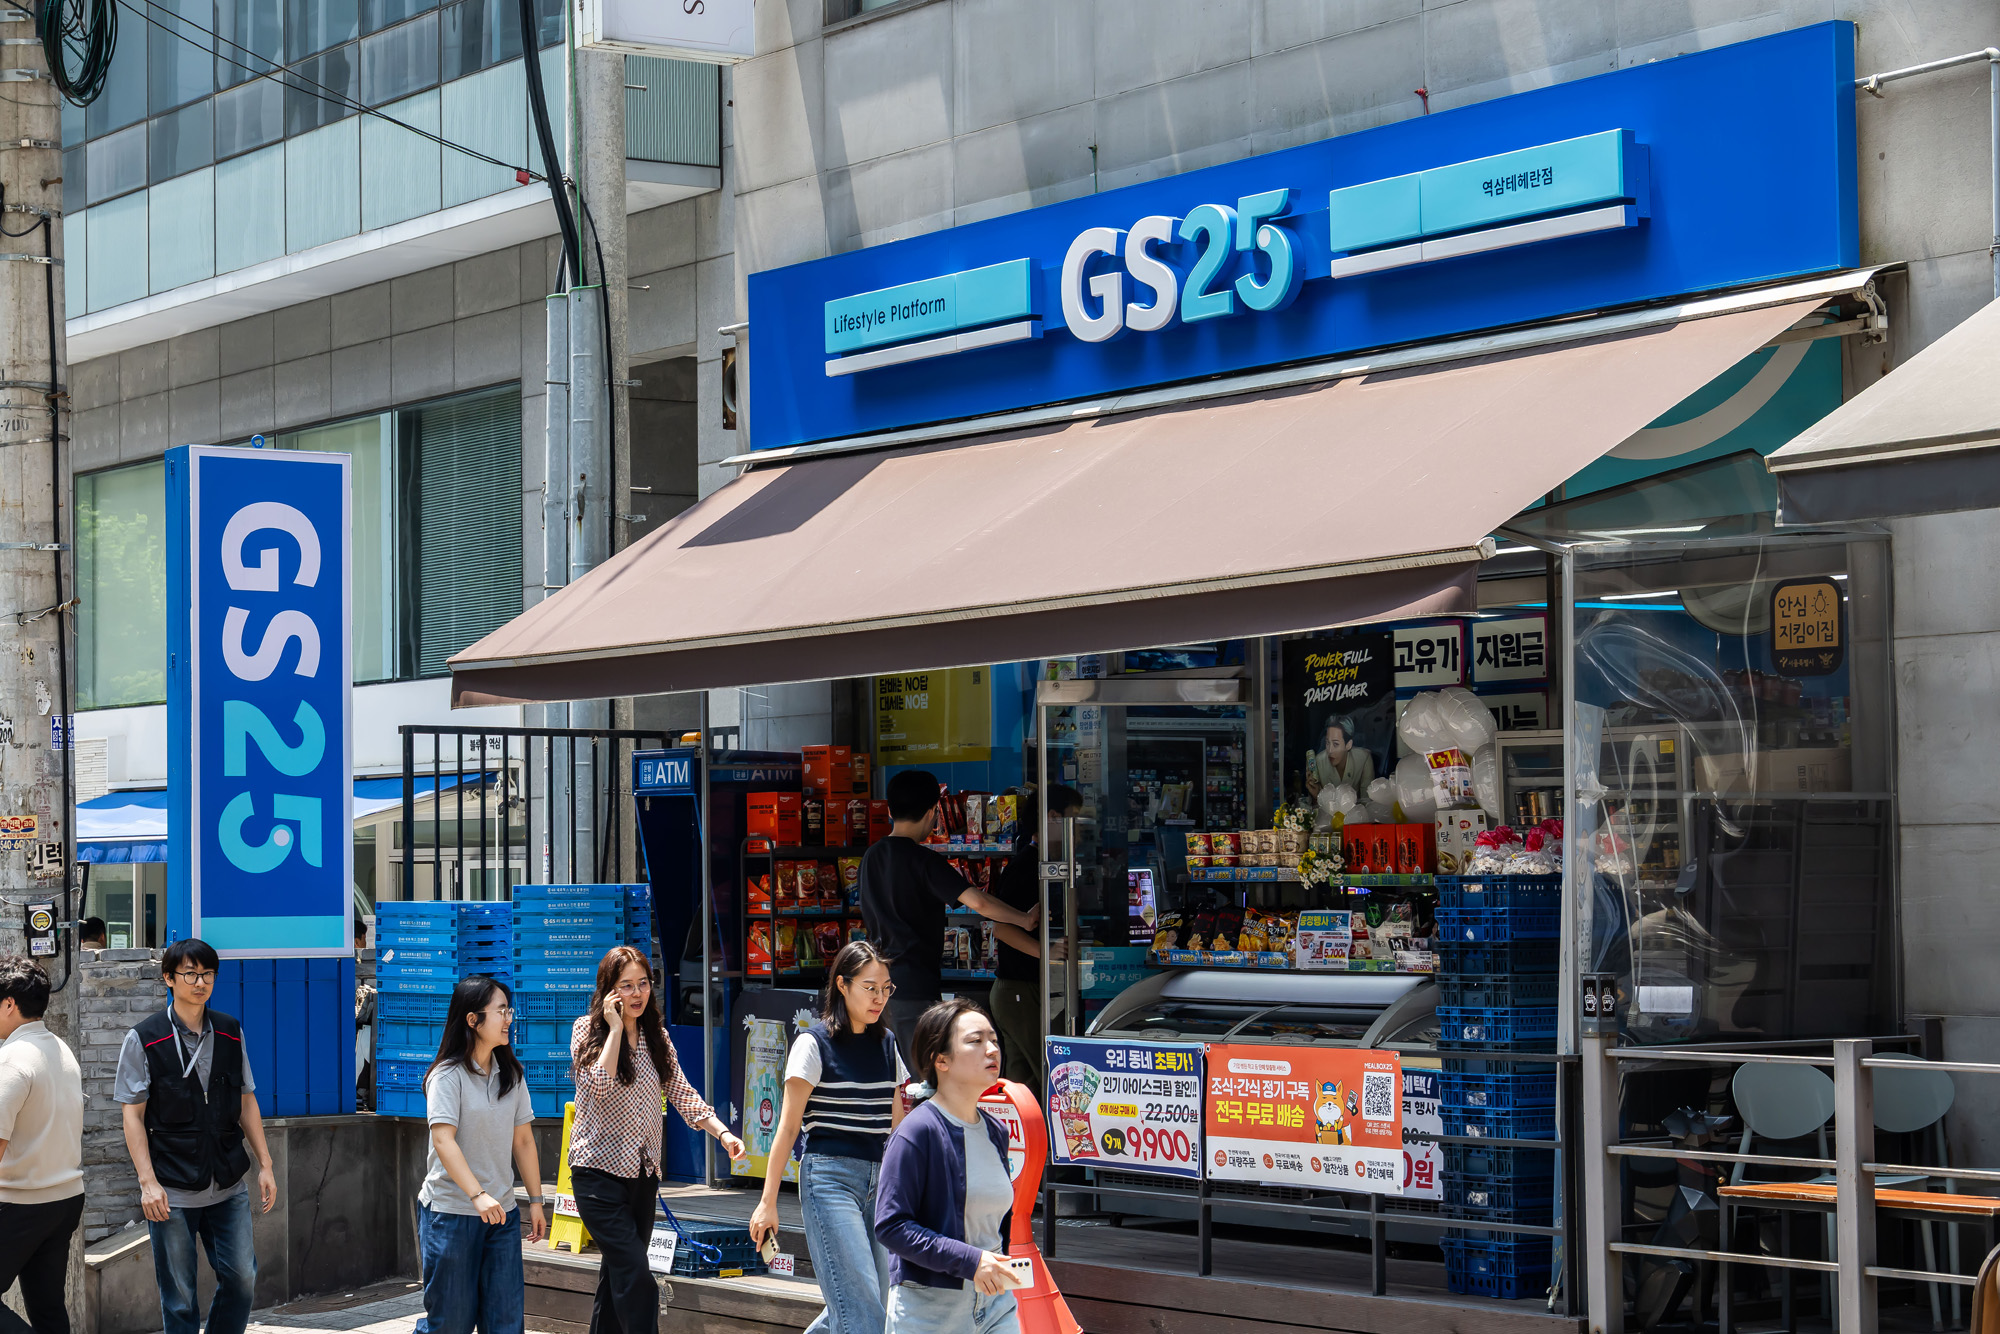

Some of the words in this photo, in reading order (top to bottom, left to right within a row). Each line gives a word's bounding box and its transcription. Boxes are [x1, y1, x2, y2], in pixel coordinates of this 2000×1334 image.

[1482, 166, 1553, 197] 역삼테헤란점
[1061, 188, 1298, 343] GS25
[833, 309, 887, 334] Lifestyle
[889, 294, 946, 322] Platform
[1778, 595, 1806, 618] 안심
[1779, 619, 1834, 644] 지킴이집
[1394, 636, 1459, 673] 고유가
[1476, 631, 1544, 668] 지원금
[1304, 648, 1373, 673] POWERFULL
[879, 677, 903, 694] 담배는
[905, 675, 929, 692] NO답
[1314, 665, 1359, 686] 탄산라거
[218, 501, 326, 874] GS25
[1304, 684, 1337, 707] DAISY
[1336, 682, 1368, 701] LAGER
[879, 695, 904, 711] 대세는
[905, 692, 929, 710] NO답
[470, 739, 487, 751] 블루
[488, 737, 501, 750] 역삼
[655, 760, 688, 784] ATM
[1300, 915, 1329, 927] 증정행사
[1391, 938, 1404, 950] 1+1
[1085, 973, 1098, 982] GS
[1099, 972, 1117, 983] Pay
[1053, 1045, 1071, 1056] GS25
[1105, 1048, 1126, 1069] 우리
[1129, 1049, 1153, 1070] 동네
[1154, 1051, 1194, 1072] 초특가!
[1364, 1062, 1393, 1070] MEALBOX25
[1069, 1078, 1083, 1086] 부라보
[1103, 1076, 1121, 1094] 인기
[1122, 1078, 1172, 1097] 아이스크림
[1174, 1080, 1197, 1098] 할인!!
[1211, 1077, 1260, 1098] 조식·간식
[1262, 1080, 1285, 1099] 정기
[1286, 1081, 1310, 1101] 구독
[1099, 1104, 1109, 1114] 9개
[1109, 1105, 1119, 1115] 이상
[1119, 1105, 1130, 1115] 구매
[1131, 1106, 1136, 1115] 시
[1145, 1103, 1198, 1124] 22,500원
[1215, 1100, 1244, 1125] 전국
[1245, 1102, 1274, 1126] 무료
[1276, 1104, 1305, 1128] 배송
[1414, 1100, 1436, 1116] 행사
[1104, 1133, 1122, 1150] 9개
[1127, 1126, 1197, 1162] 9,900원
[1228, 1156, 1256, 1168] 대량주문
[1275, 1159, 1303, 1172] 무료배송
[1323, 1162, 1349, 1176] 알찬상품
[1366, 1167, 1394, 1181] 할인혜택
[563, 1198, 579, 1212] 계단조
[650, 1236, 673, 1250] 심하세요
